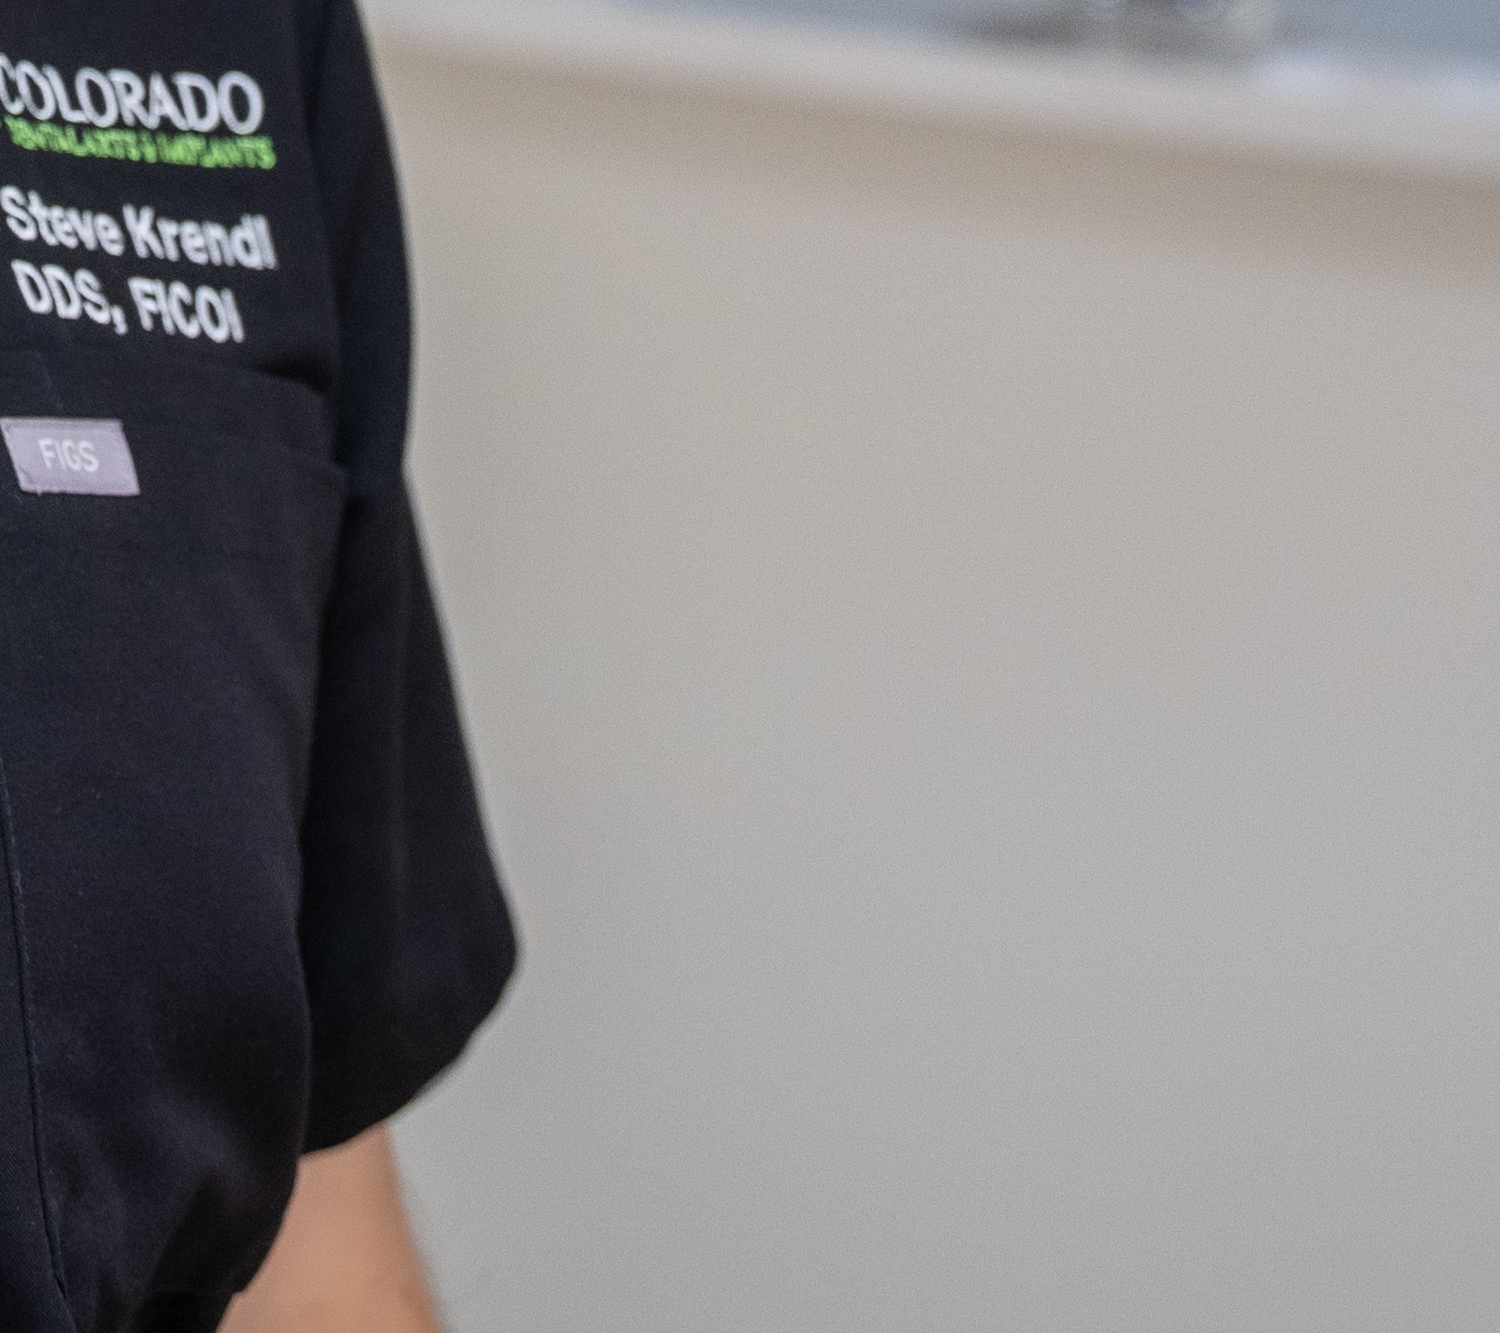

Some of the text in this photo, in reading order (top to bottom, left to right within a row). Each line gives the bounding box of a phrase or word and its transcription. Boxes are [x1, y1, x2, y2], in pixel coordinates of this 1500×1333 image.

[0, 185, 125, 256] Steve
[122, 202, 279, 270] Krendl
[11, 259, 245, 343] DDS, FICOI
[38, 438, 99, 472] FIGS
